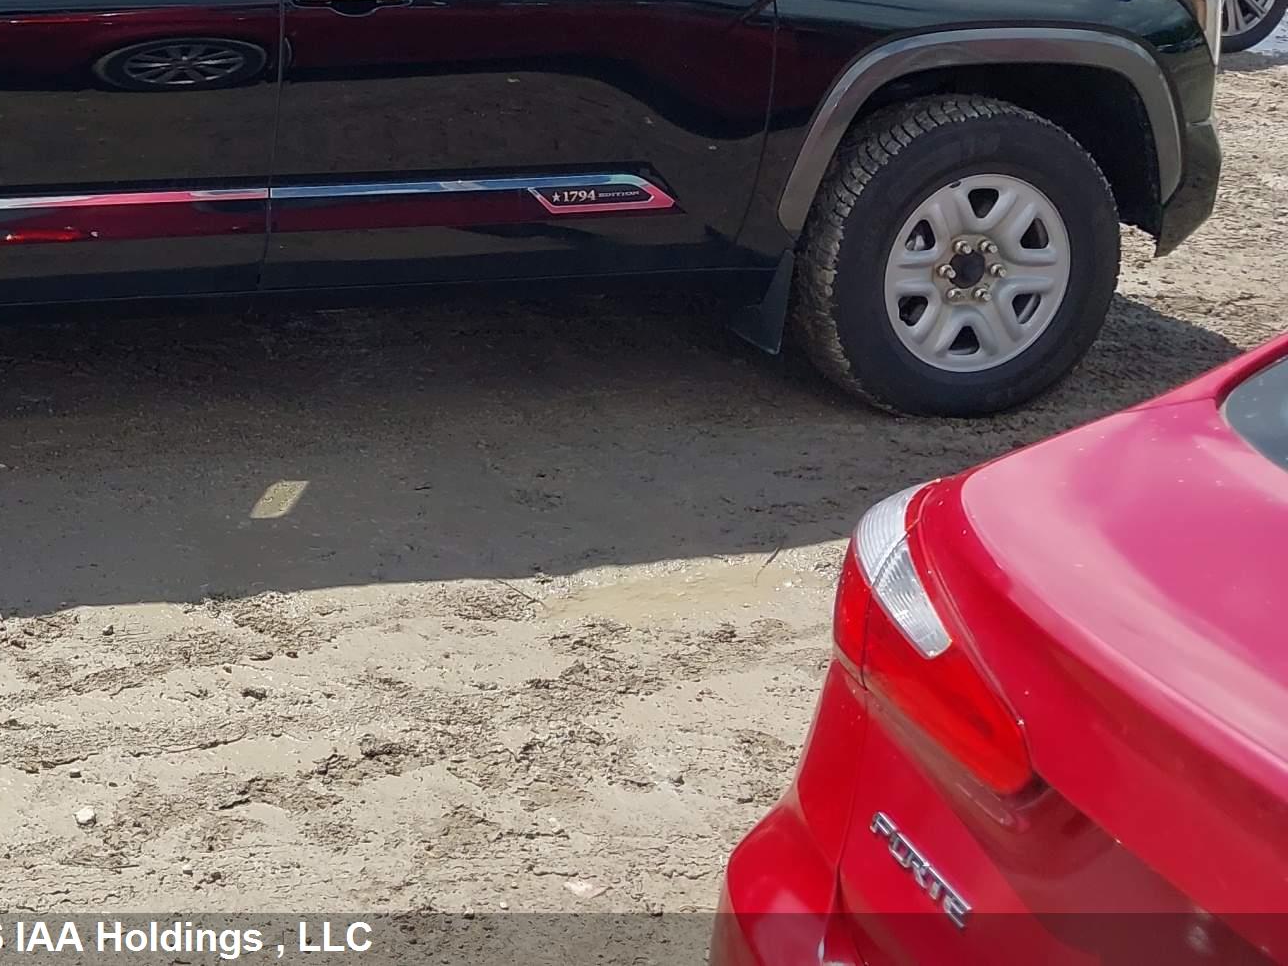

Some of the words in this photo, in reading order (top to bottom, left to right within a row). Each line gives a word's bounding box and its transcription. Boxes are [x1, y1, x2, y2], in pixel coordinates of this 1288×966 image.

[562, 189, 596, 202] 1794
[598, 190, 639, 198] EDITION
[869, 811, 972, 928] FORTE
